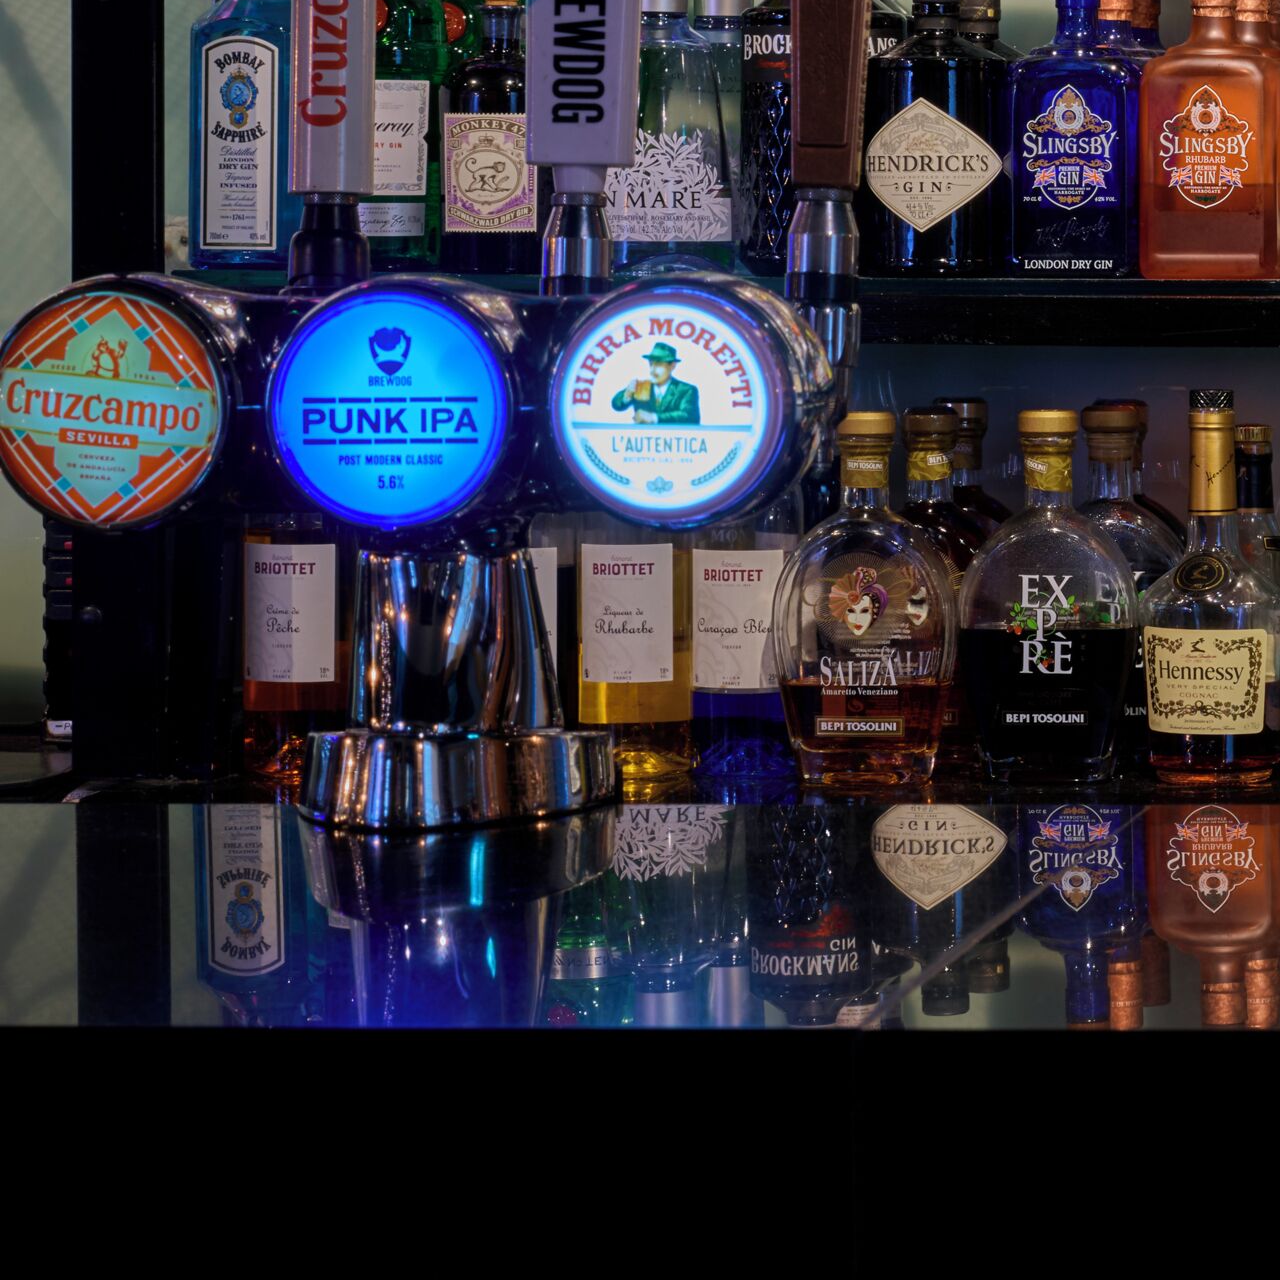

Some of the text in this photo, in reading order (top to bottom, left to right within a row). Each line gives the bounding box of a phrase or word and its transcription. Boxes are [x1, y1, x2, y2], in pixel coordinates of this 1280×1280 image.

[214, 51, 266, 74] BOMBAY
[211, 120, 268, 144] SAPPHIRE
[1022, 132, 1116, 159] SLINGSBY
[1160, 132, 1253, 158] SLINGSBY
[868, 153, 990, 174] HENDRICK'S
[626, 190, 704, 210] MARE
[1024, 260, 1114, 270] LONDON DRY GIN
[572, 318, 754, 410] BIRRA MORETTI
[368, 376, 413, 388] BREWDOG
[6, 377, 200, 436] Cruzcampo
[302, 407, 478, 434] PUNK IPA
[66, 432, 132, 447] SEVILLA
[612, 436, 708, 455] L'AUTENTICA
[338, 455, 444, 466] POST MODERN CLASSIC
[378, 474, 406, 490] 5.6%
[254, 562, 316, 576] BRIOTTET
[704, 569, 764, 583] BRIOTTET
[1158, 660, 1244, 686] Hennessy
[821, 688, 899, 696] Amaretto Veneziano
[821, 722, 897, 732] BEPI TOSOLINI
